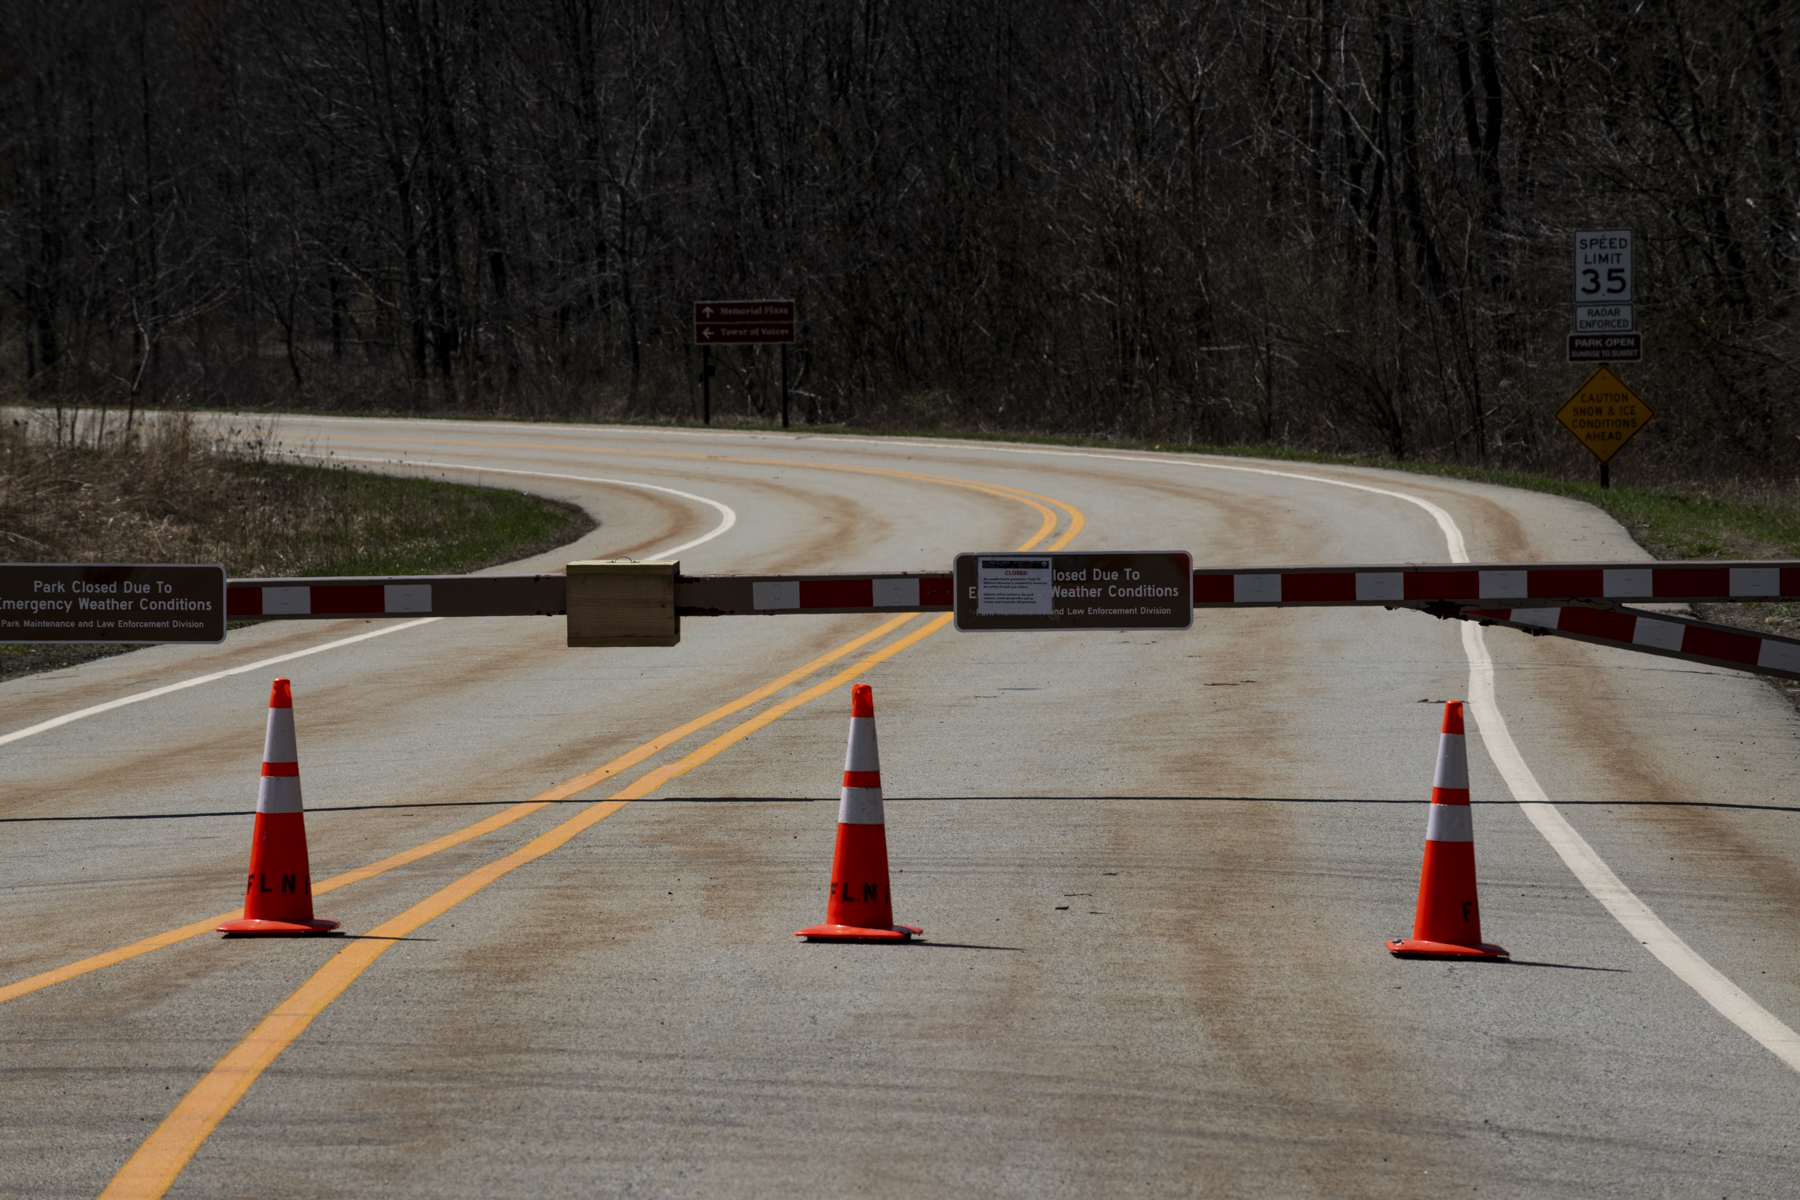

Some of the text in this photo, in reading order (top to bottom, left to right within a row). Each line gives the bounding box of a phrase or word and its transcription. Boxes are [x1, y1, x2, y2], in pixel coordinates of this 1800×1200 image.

[1579, 237, 1628, 250] SPEED
[1584, 253, 1623, 265] LIMIT
[1581, 268, 1627, 294] 35
[720, 305, 788, 315] Memorial Plaza
[1587, 308, 1621, 317] RADAR
[1579, 319, 1629, 329] ENFORCED
[720, 327, 789, 336] Tower of Voices
[1574, 337, 1635, 348] PARK OPEN
[1571, 349, 1639, 358] SUNRISE TO SUNSET
[1580, 392, 1628, 403] CAUTION
[1572, 405, 1637, 416] SNOW & ICE
[1572, 418, 1637, 429] CONDITIONS
[1585, 431, 1622, 442] AHEAD
[1053, 568, 1140, 581] losed Due To
[33, 580, 172, 594] Park Closed Due To
[1051, 585, 1179, 598] Weather Conditions
[78, 597, 133, 610] Weather
[139, 597, 212, 611] Conditions
[1067, 607, 1085, 615] Law
[1087, 606, 1138, 615] Enforcement
[1140, 606, 1171, 615] Division
[1, 619, 204, 628] Park Maintenance and Law Enforcement Division
